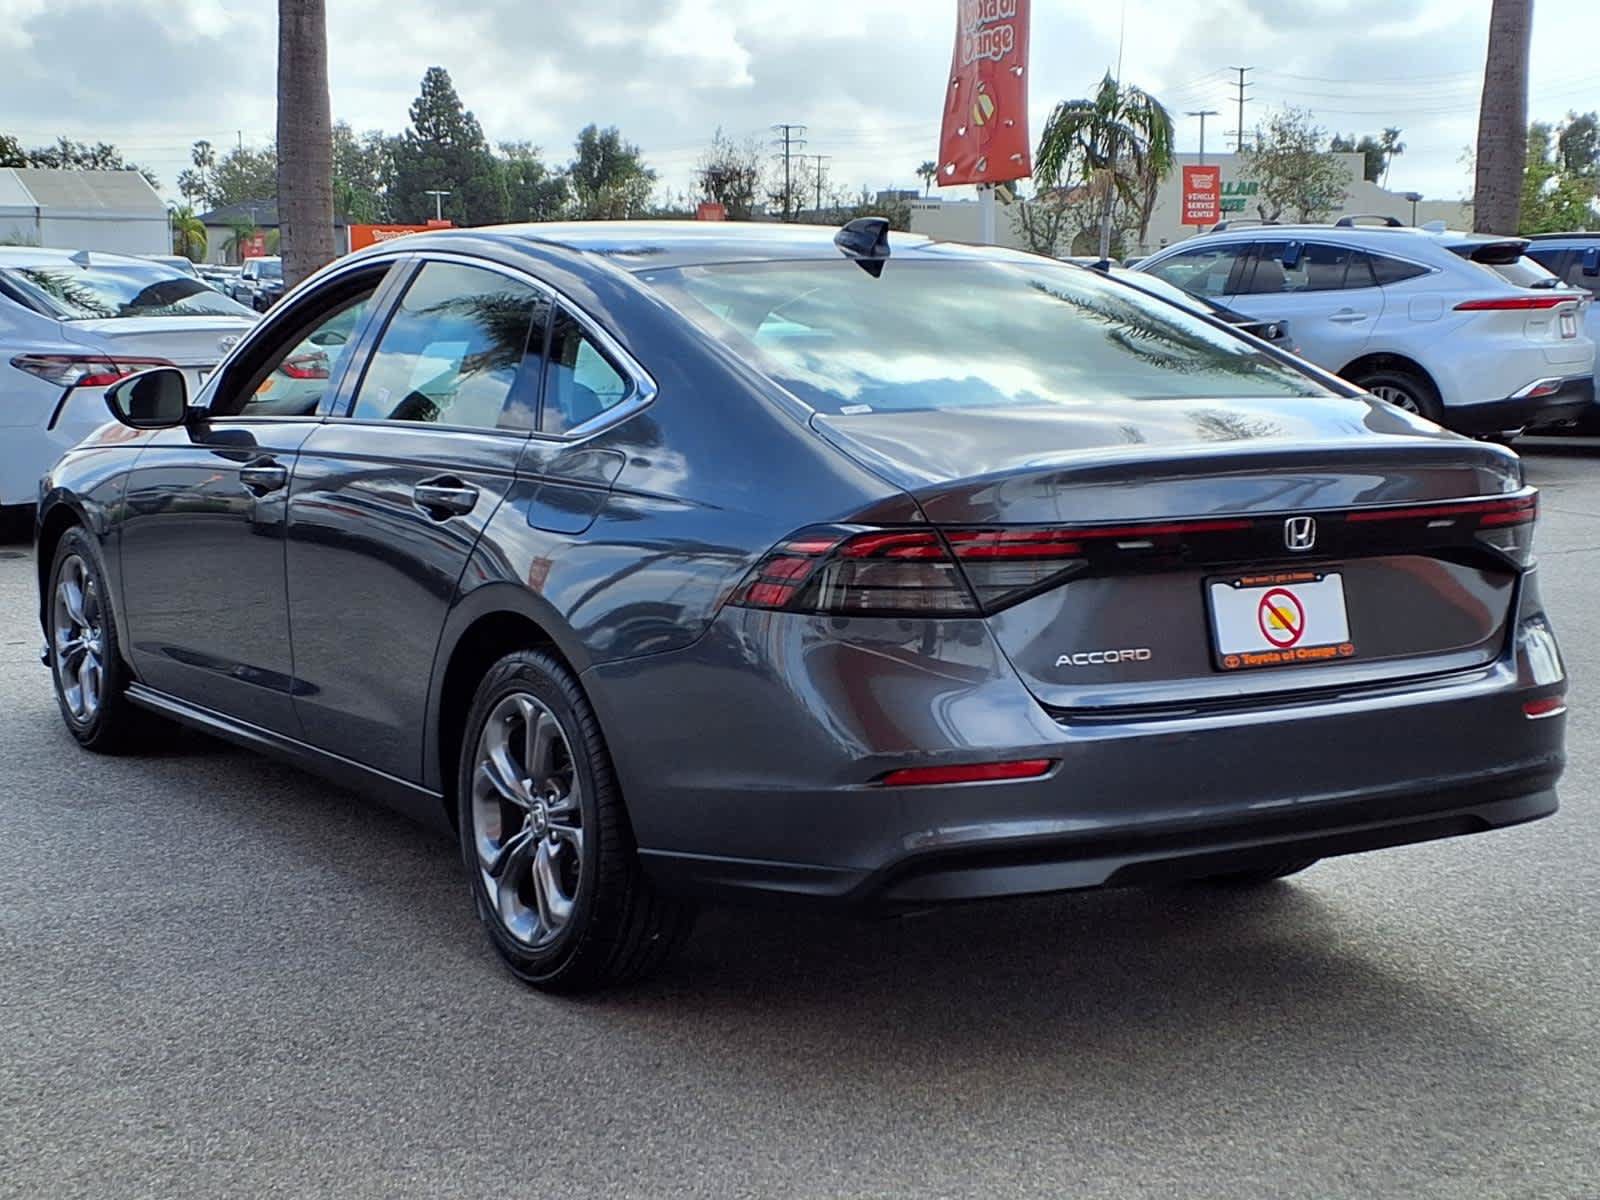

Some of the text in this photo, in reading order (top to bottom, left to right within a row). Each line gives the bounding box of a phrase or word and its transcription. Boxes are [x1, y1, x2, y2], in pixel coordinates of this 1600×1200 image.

[1187, 193, 1216, 201] VEHICLE
[1187, 210, 1214, 218] CENTER
[1055, 648, 1152, 667] ACCORD
[1241, 647, 1337, 665] Toyota of Orange
